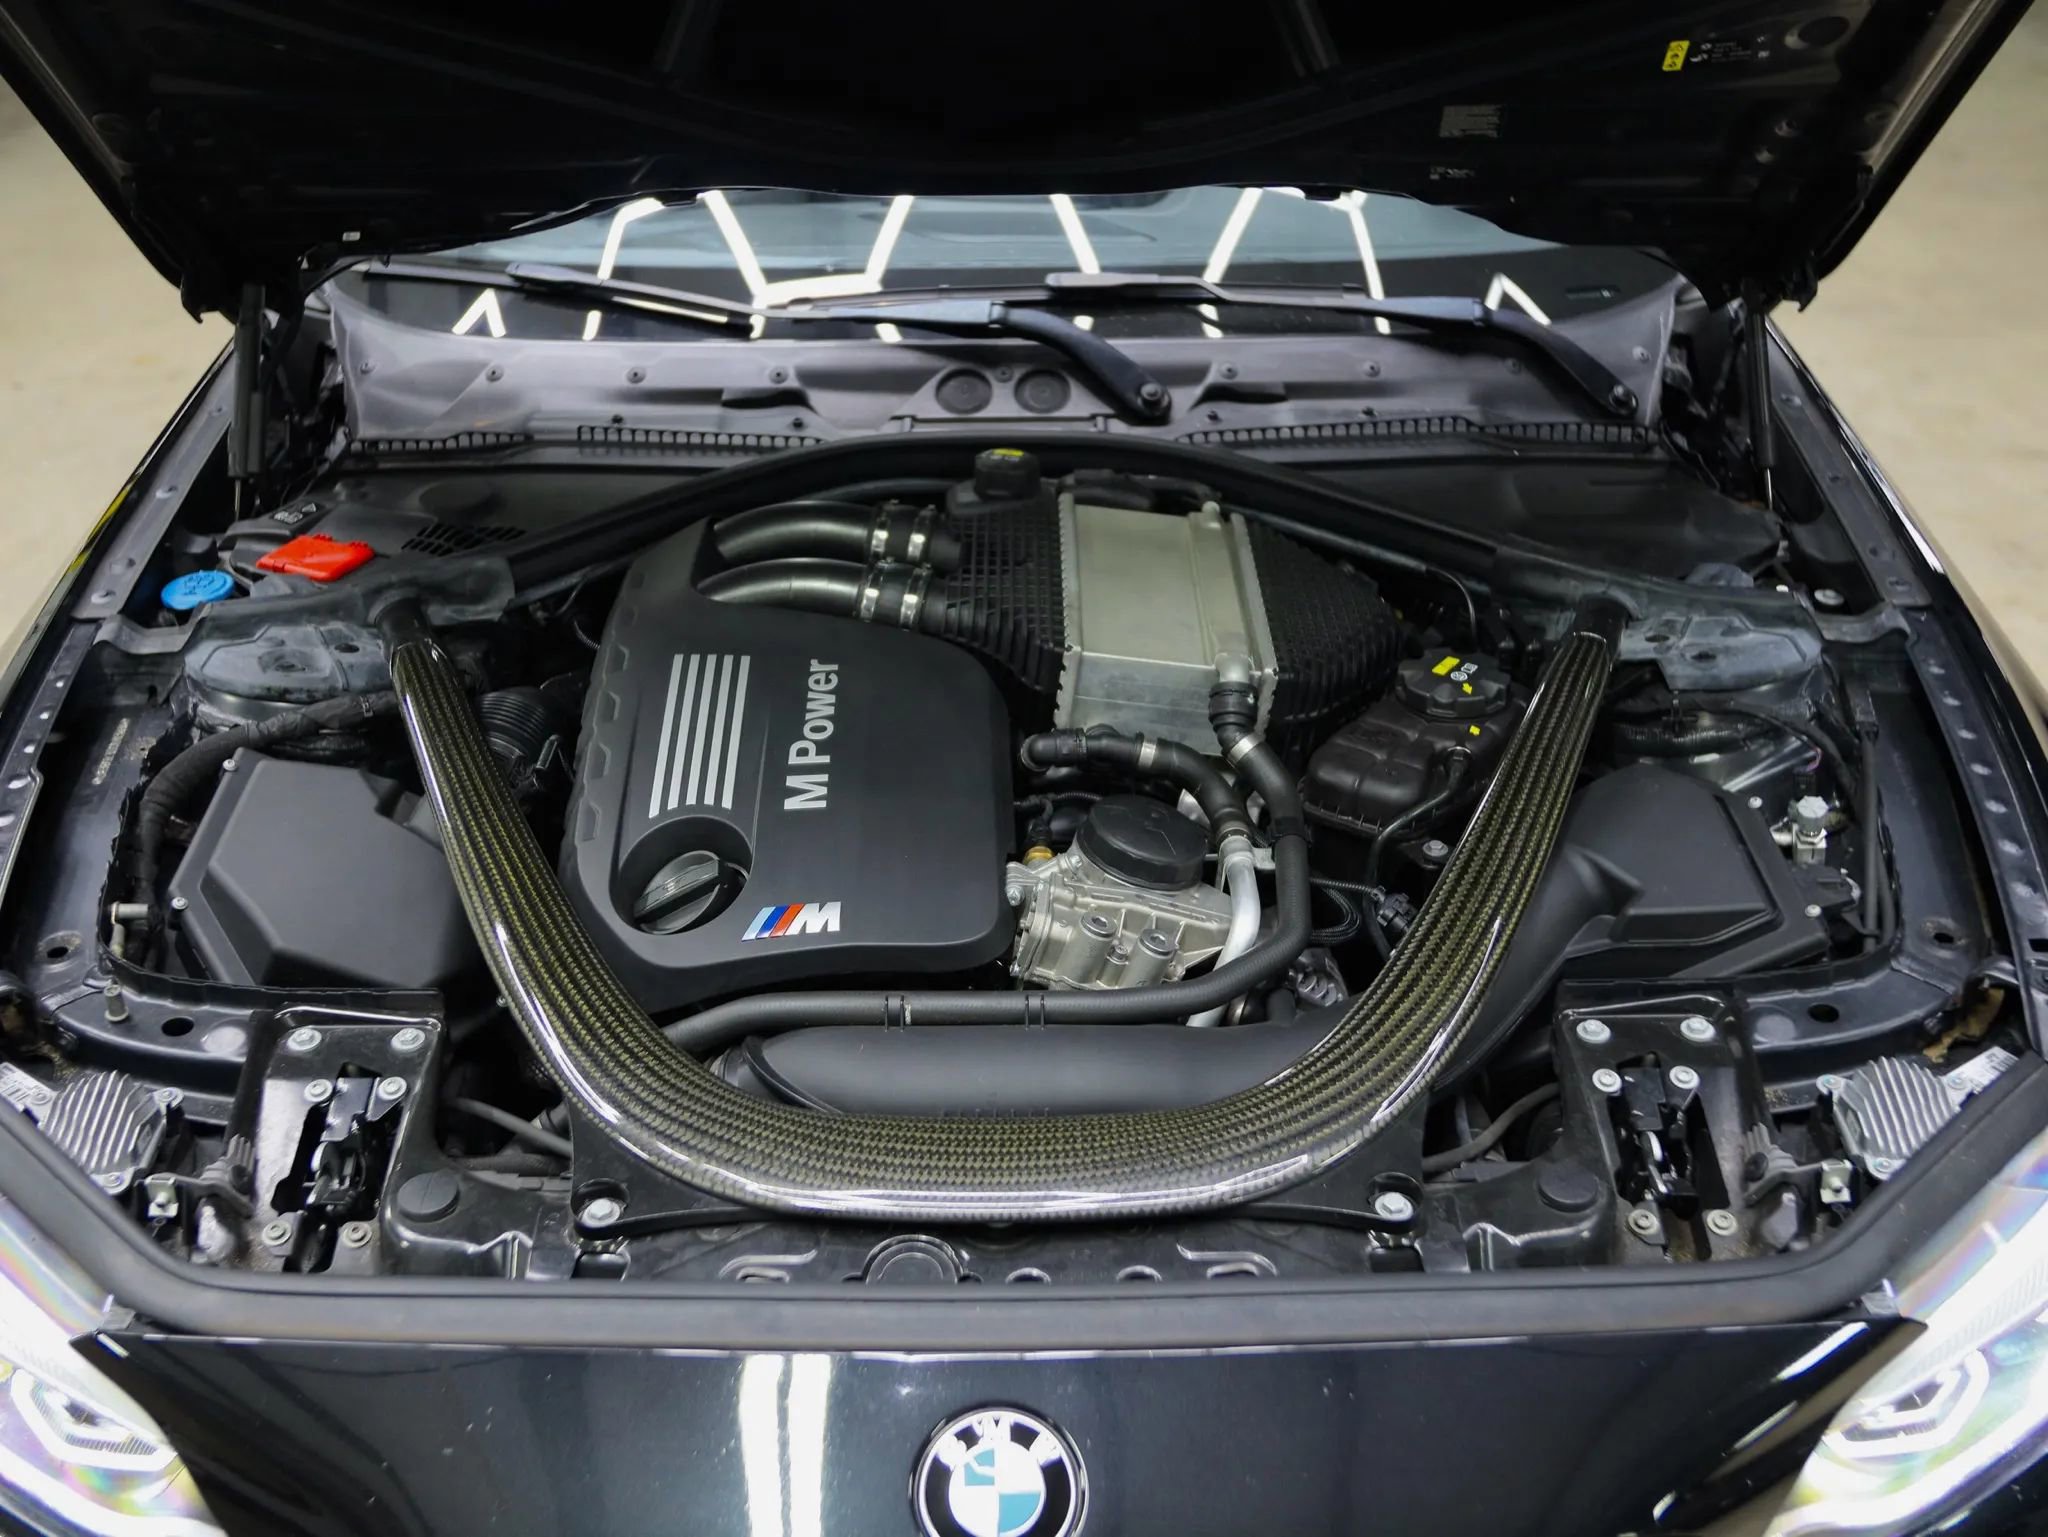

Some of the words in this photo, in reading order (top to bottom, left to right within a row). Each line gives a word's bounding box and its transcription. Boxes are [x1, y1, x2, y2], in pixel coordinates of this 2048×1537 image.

[788, 659, 839, 764] Power
[784, 774, 829, 809] M
[937, 1415, 1063, 1471] BMW
